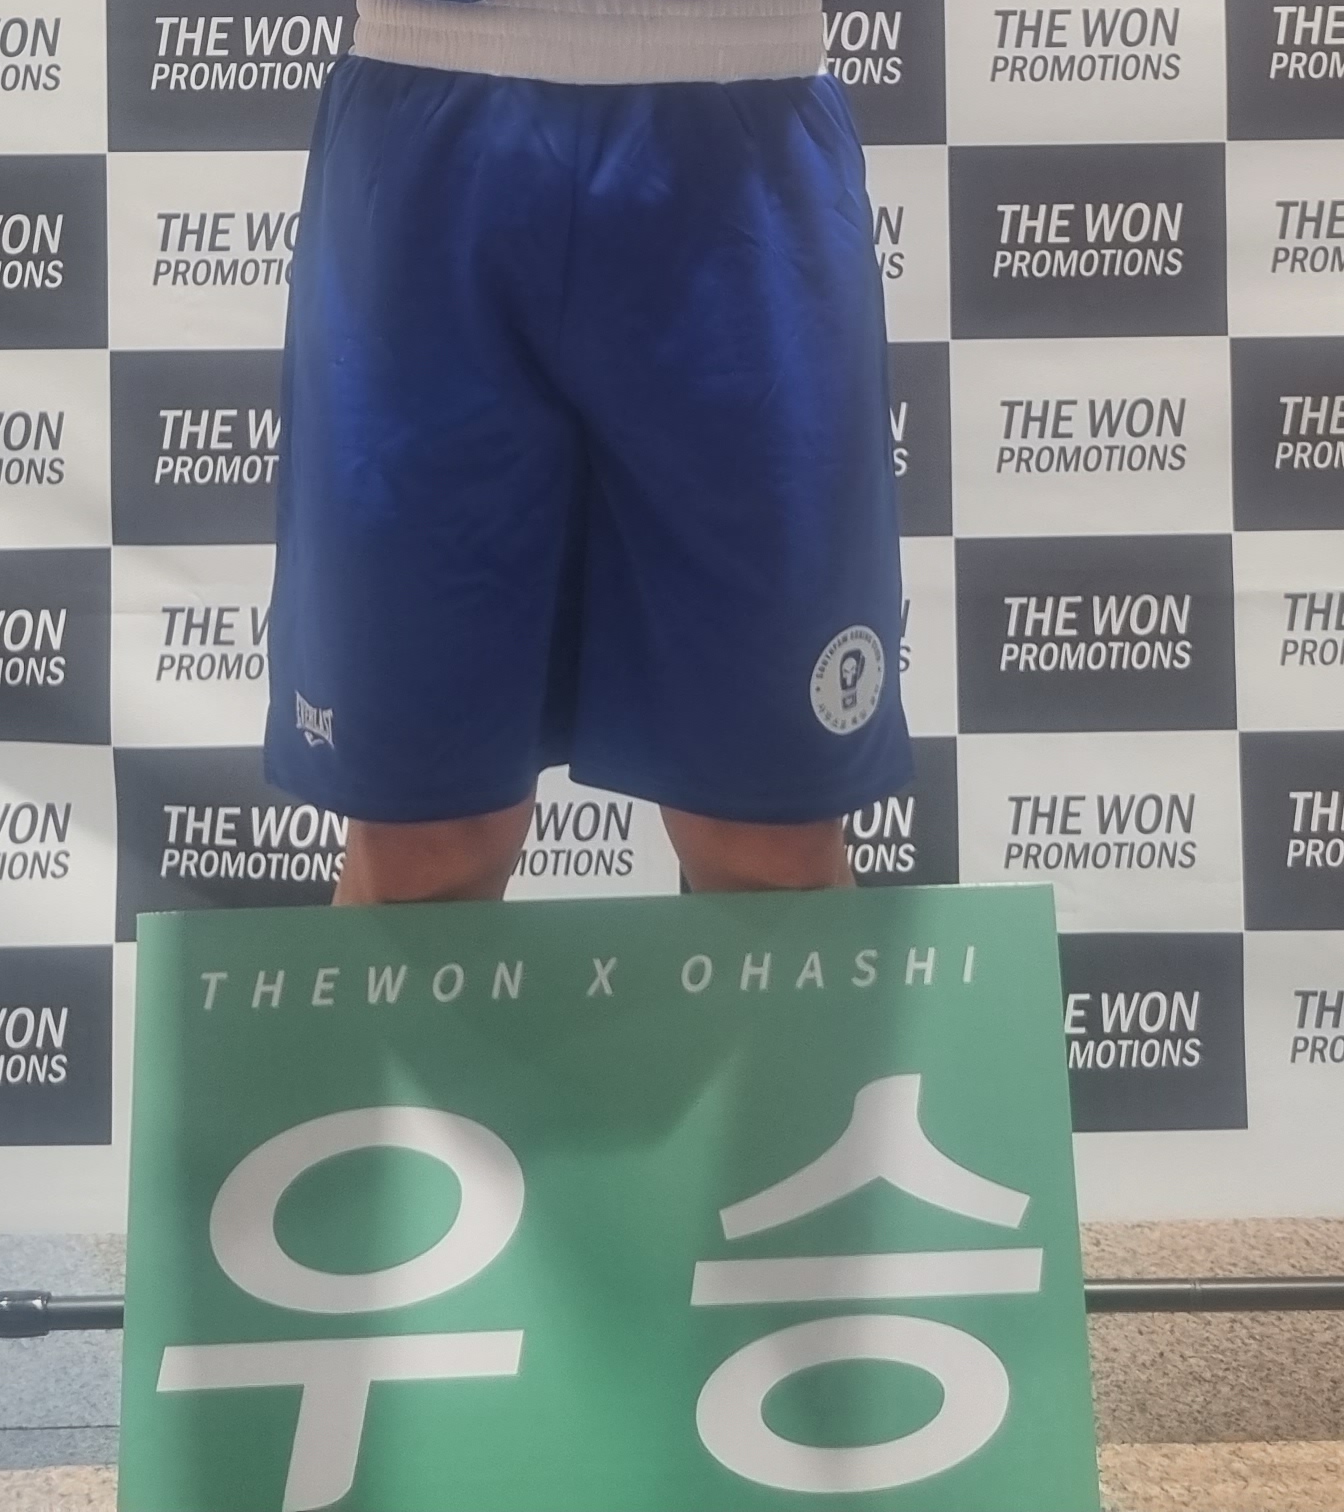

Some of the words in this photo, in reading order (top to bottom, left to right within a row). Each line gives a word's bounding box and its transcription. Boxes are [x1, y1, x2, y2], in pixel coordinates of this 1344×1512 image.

[993, 8, 1072, 49] THE
[1082, 7, 1180, 48] WON
[989, 52, 1182, 83] PROMOTIONS
[996, 203, 1076, 245] THE
[1084, 201, 1184, 244] WON
[992, 247, 1184, 279] PROMOTIONS
[201, 961, 523, 1010] THEWON
[587, 957, 616, 996] X
[681, 944, 980, 996] OHASHI
